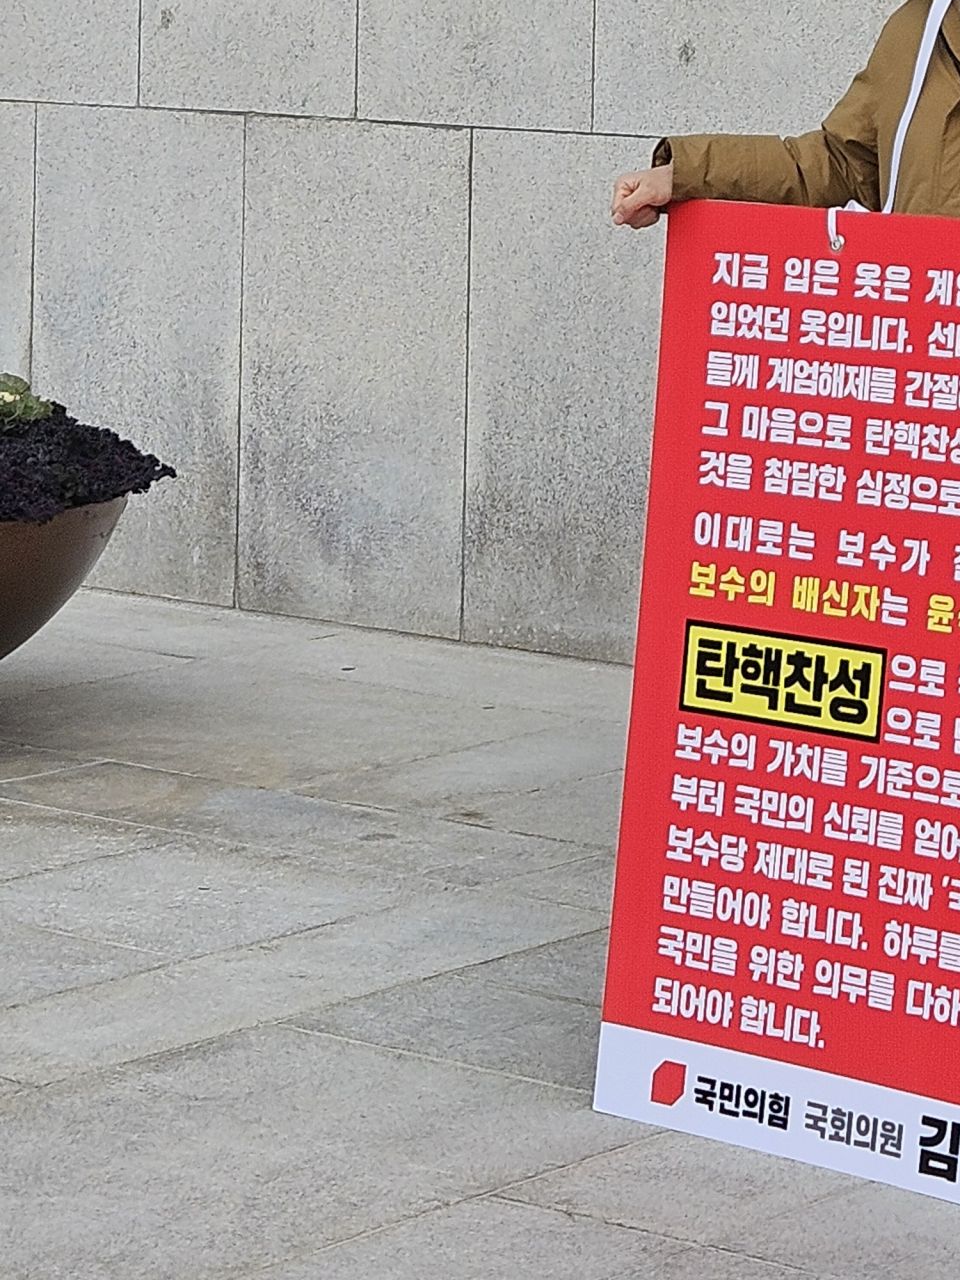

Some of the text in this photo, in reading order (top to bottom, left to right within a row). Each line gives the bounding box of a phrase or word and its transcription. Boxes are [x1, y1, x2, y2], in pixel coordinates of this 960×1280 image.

[712, 252, 769, 290] 지금
[783, 257, 840, 297] 입은
[853, 262, 911, 303] 옷은
[710, 301, 790, 343] 입었던
[799, 309, 913, 354] 옷입니다.
[705, 350, 760, 390] 들께
[765, 357, 897, 405] 계엄해제를
[701, 400, 730, 437] 그
[741, 405, 852, 451] 마음으로
[698, 450, 753, 491] 것을
[763, 457, 847, 502] 참담한
[694, 511, 815, 561] 이대로는
[836, 529, 931, 577] 보수가
[688, 561, 776, 607] 보수의
[791, 575, 909, 627] 배신자는
[695, 637, 873, 725] 탄핵찬성
[888, 654, 946, 698] 으로
[674, 723, 757, 771] 보수의
[766, 739, 848, 787] 가치를
[883, 706, 942, 750] 으로
[670, 773, 725, 818] 부터
[734, 784, 815, 834] 국민의
[823, 801, 904, 852] 신뢰를
[665, 824, 749, 873] 보수당
[753, 841, 834, 891] 제대로
[842, 857, 870, 898] 된
[878, 864, 934, 911] 진짜
[662, 875, 772, 931] 만들어야
[780, 898, 868, 951] 합니다.
[657, 925, 738, 977] 국민을
[748, 945, 805, 991] 위한
[812, 959, 895, 1012] 의무를
[651, 976, 825, 1049] 되어야 합니다.
[693, 1075, 791, 1131] 국민의힘
[804, 1101, 904, 1159] 국회의원
